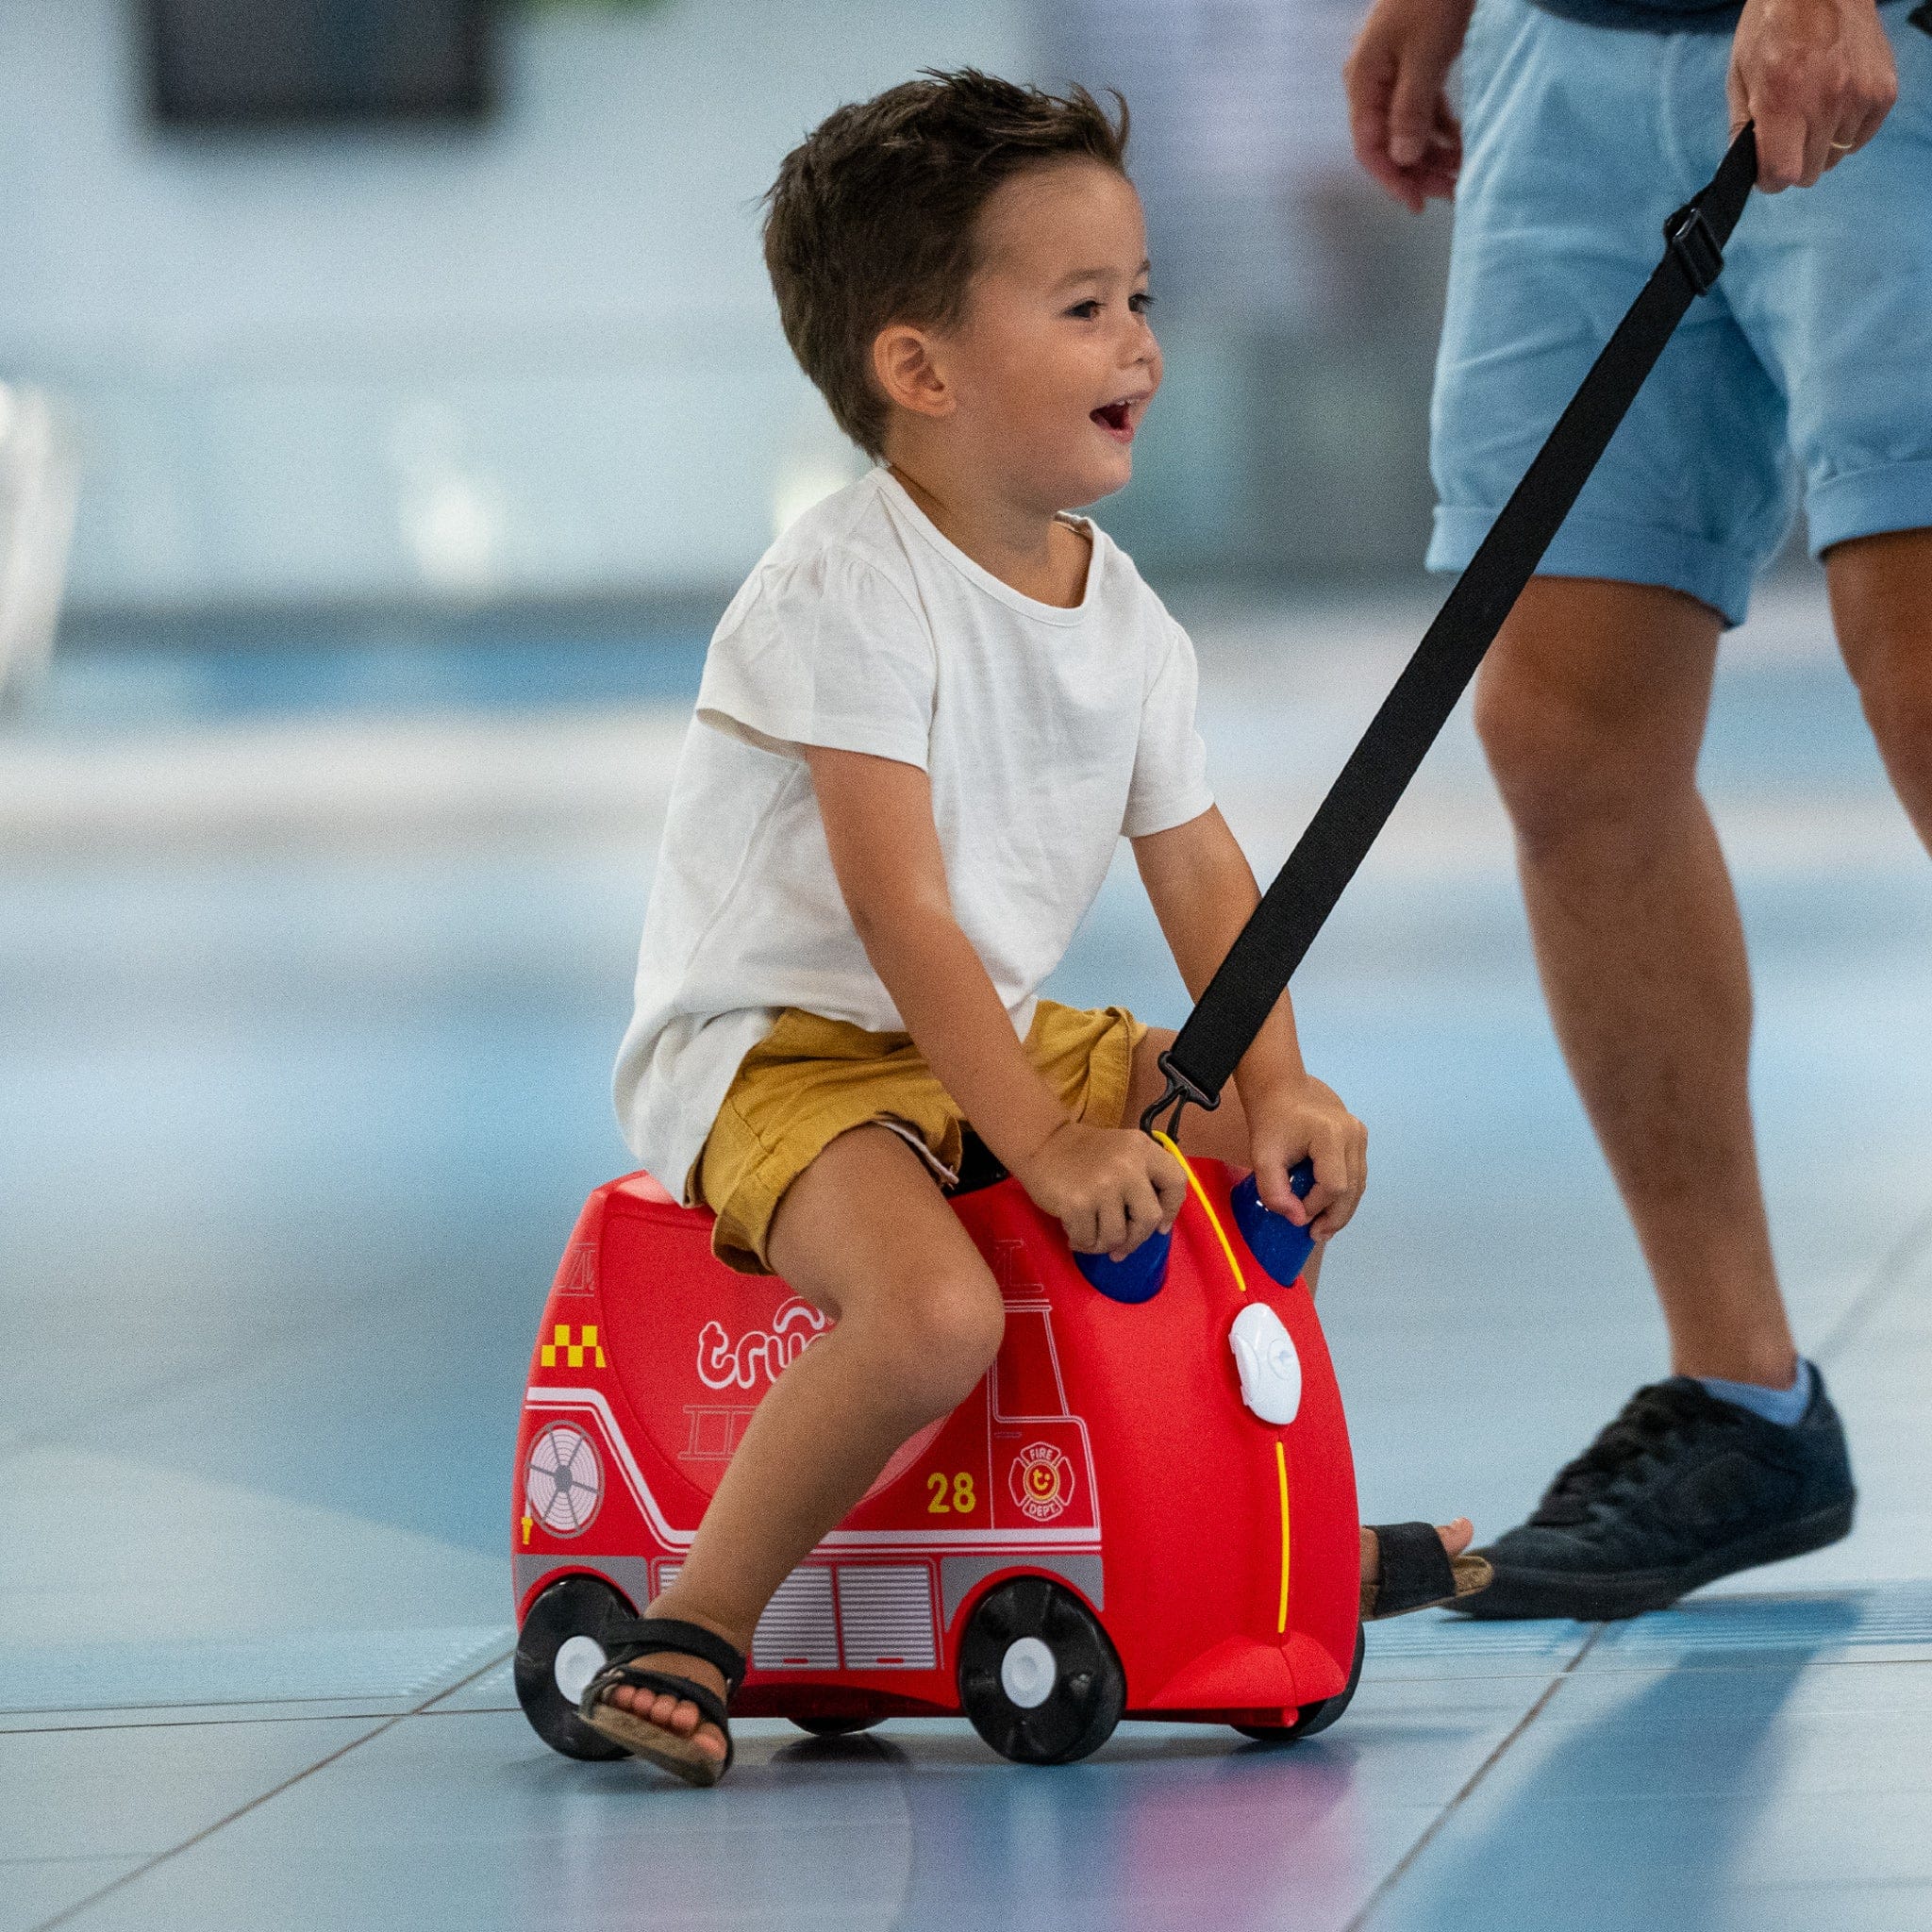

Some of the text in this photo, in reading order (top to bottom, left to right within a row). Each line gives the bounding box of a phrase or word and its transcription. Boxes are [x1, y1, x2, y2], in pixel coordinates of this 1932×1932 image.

[697, 1296, 826, 1390] tru
[1029, 1447, 1054, 1460] FIRE
[927, 1472, 976, 1513] 28
